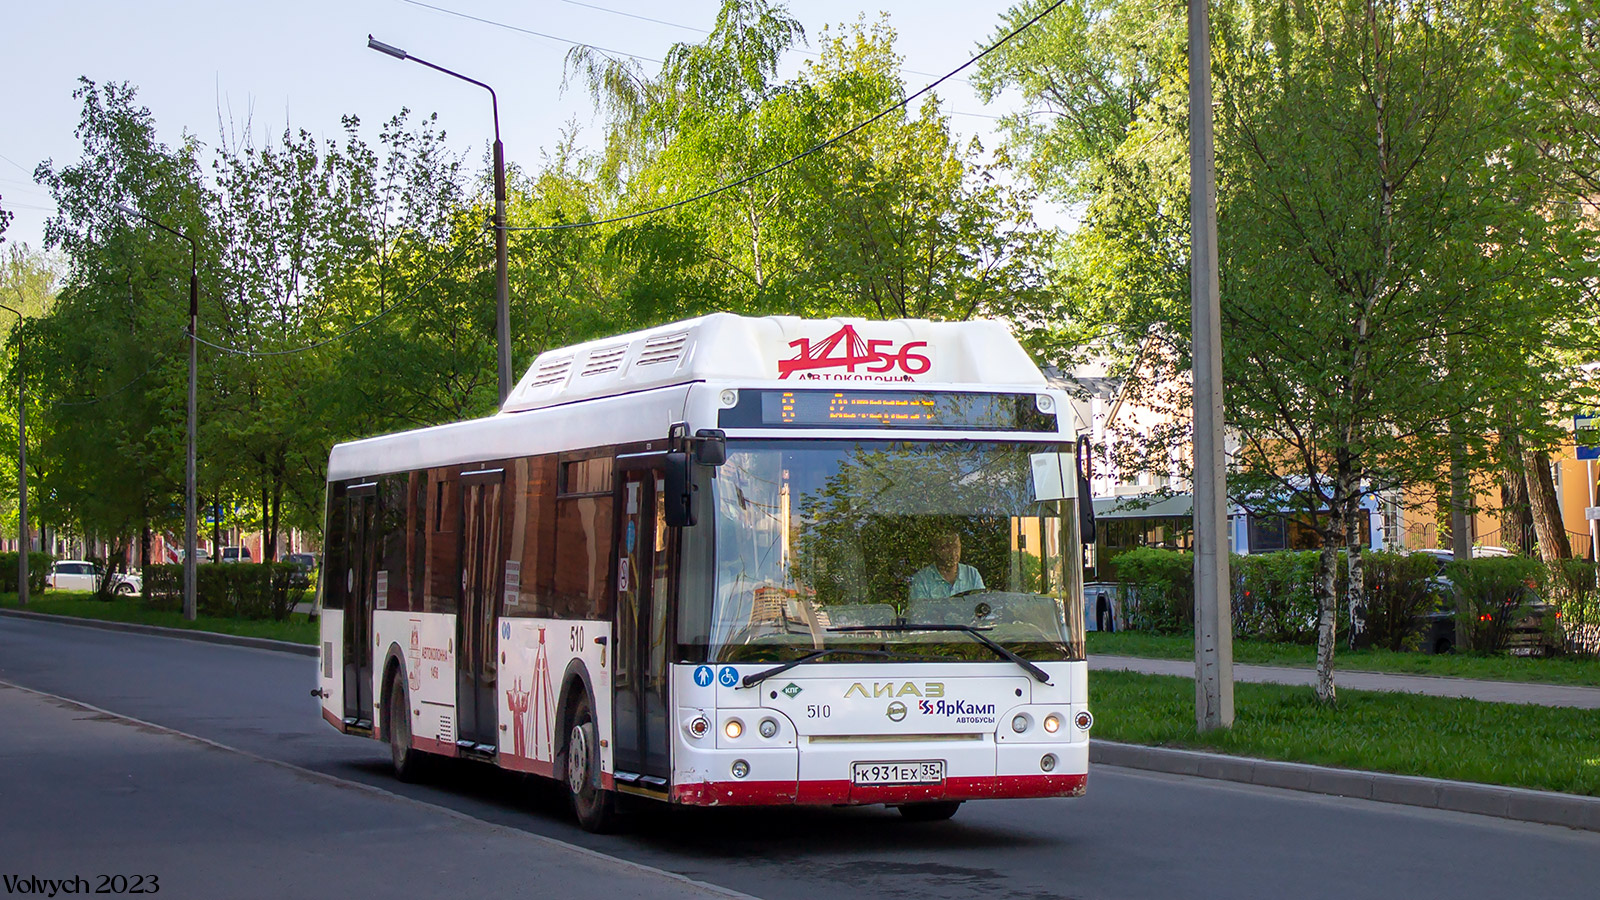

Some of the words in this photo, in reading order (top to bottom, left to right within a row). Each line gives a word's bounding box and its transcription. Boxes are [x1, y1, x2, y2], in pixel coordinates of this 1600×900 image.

[777, 324, 932, 375] 1456
[570, 625, 585, 653] 510
[784, 686, 799, 694] КПГ
[807, 704, 832, 719] 510
[935, 700, 996, 717] ЯрКамп
[955, 716, 996, 724] АВТОБУСЫ
[861, 765, 918, 781] К931ЕХ
[921, 764, 936, 776] 35
